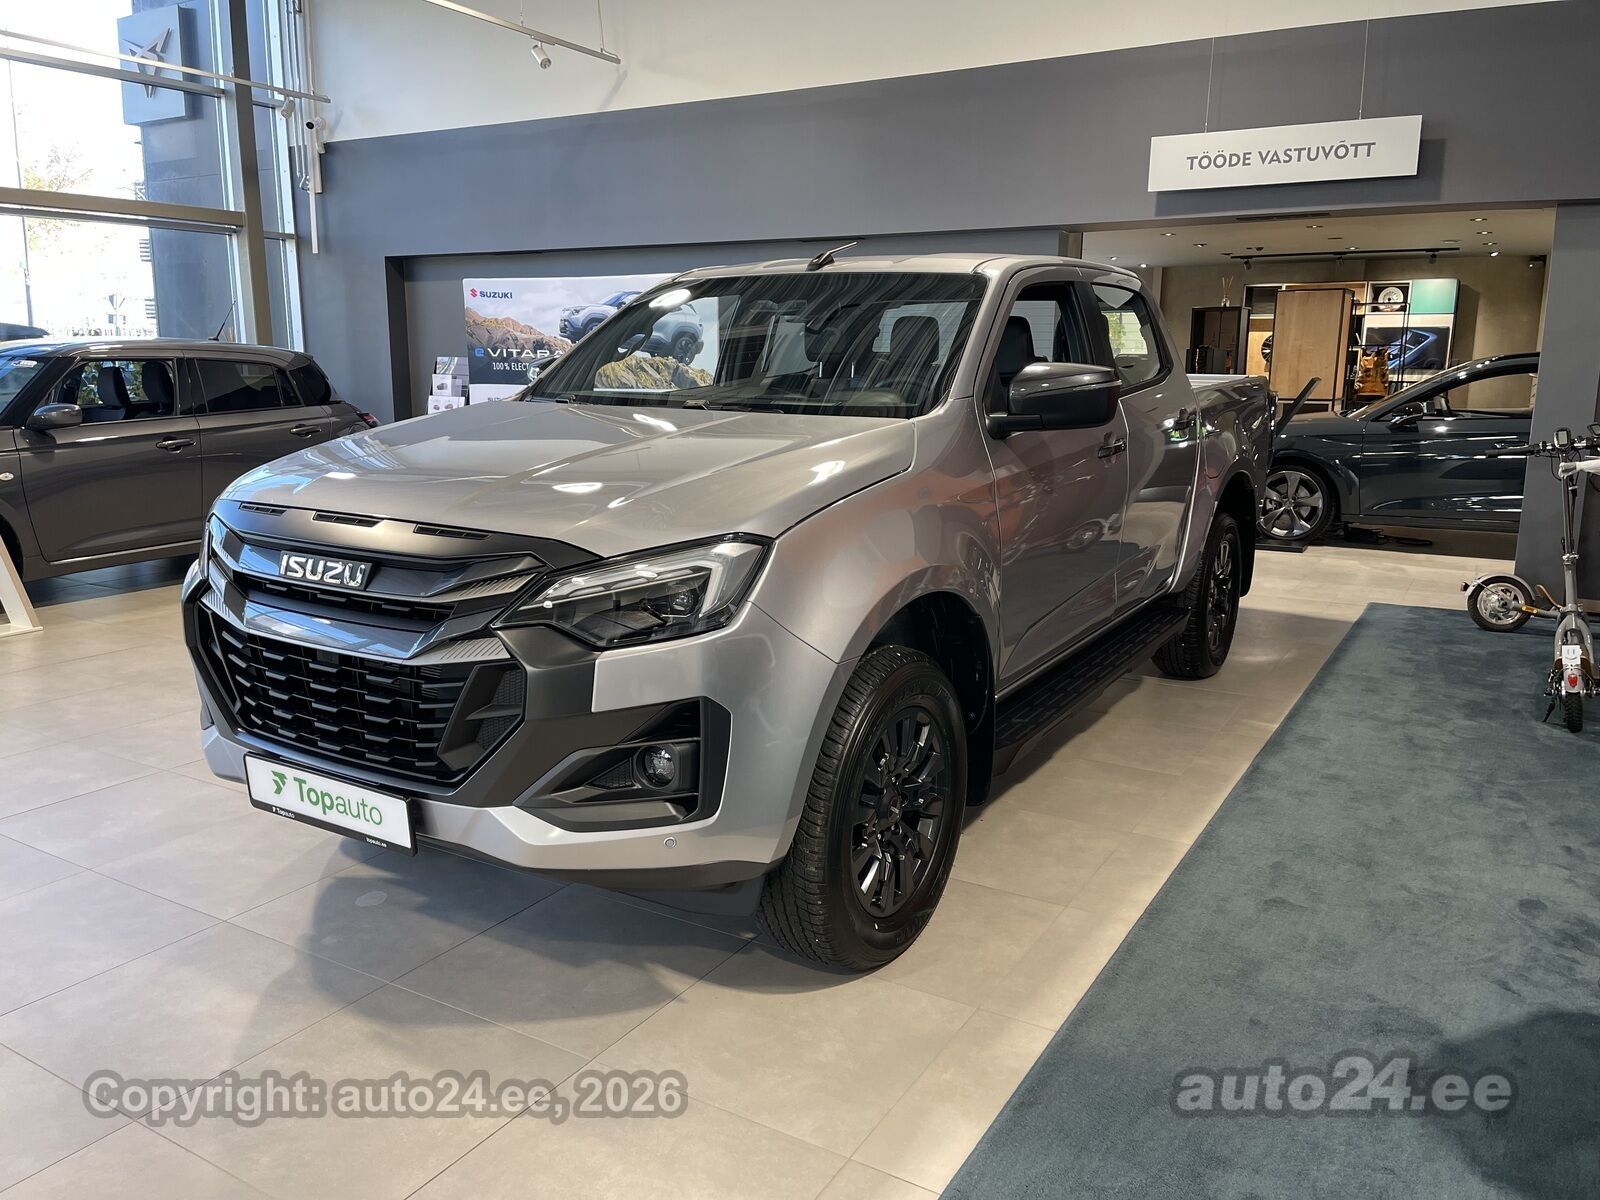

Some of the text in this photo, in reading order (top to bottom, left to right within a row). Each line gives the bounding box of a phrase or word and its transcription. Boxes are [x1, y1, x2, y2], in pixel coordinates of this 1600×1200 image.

[1186, 140, 1377, 170] TÖÖDE VASTUVÕTT
[479, 291, 513, 299] SUZUKI
[280, 554, 366, 587] ISUZU
[293, 776, 383, 826] Topauto
